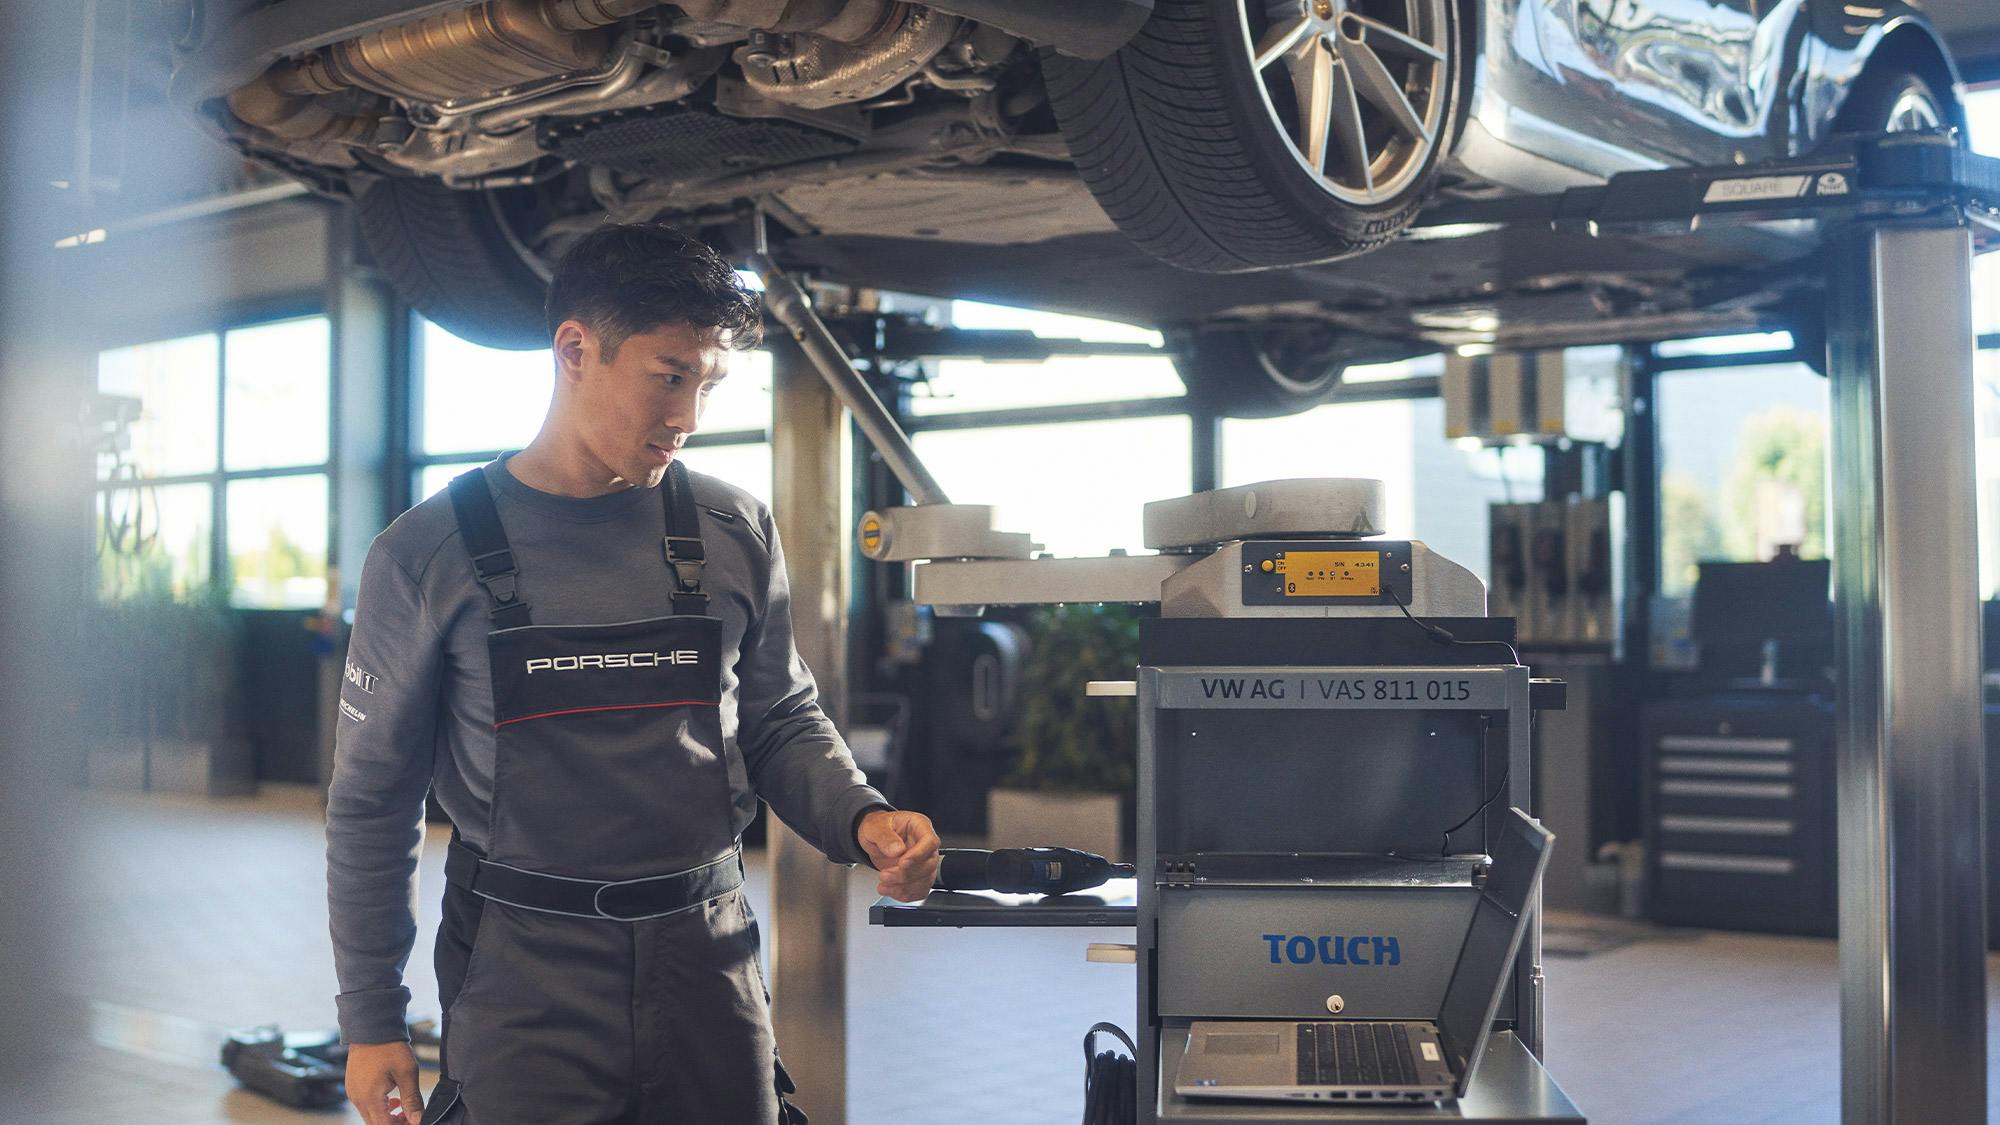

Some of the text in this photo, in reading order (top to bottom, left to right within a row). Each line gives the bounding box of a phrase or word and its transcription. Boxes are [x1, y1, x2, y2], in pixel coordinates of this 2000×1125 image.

[344, 656, 362, 687] obil
[526, 650, 699, 674] PORSCHE
[1201, 678, 1245, 699] VW
[1250, 678, 1285, 699] AG
[1317, 679, 1366, 700] VAS
[1373, 679, 1418, 700] 811
[1426, 680, 1470, 701] 015
[1263, 934, 1401, 966] TOUCH
